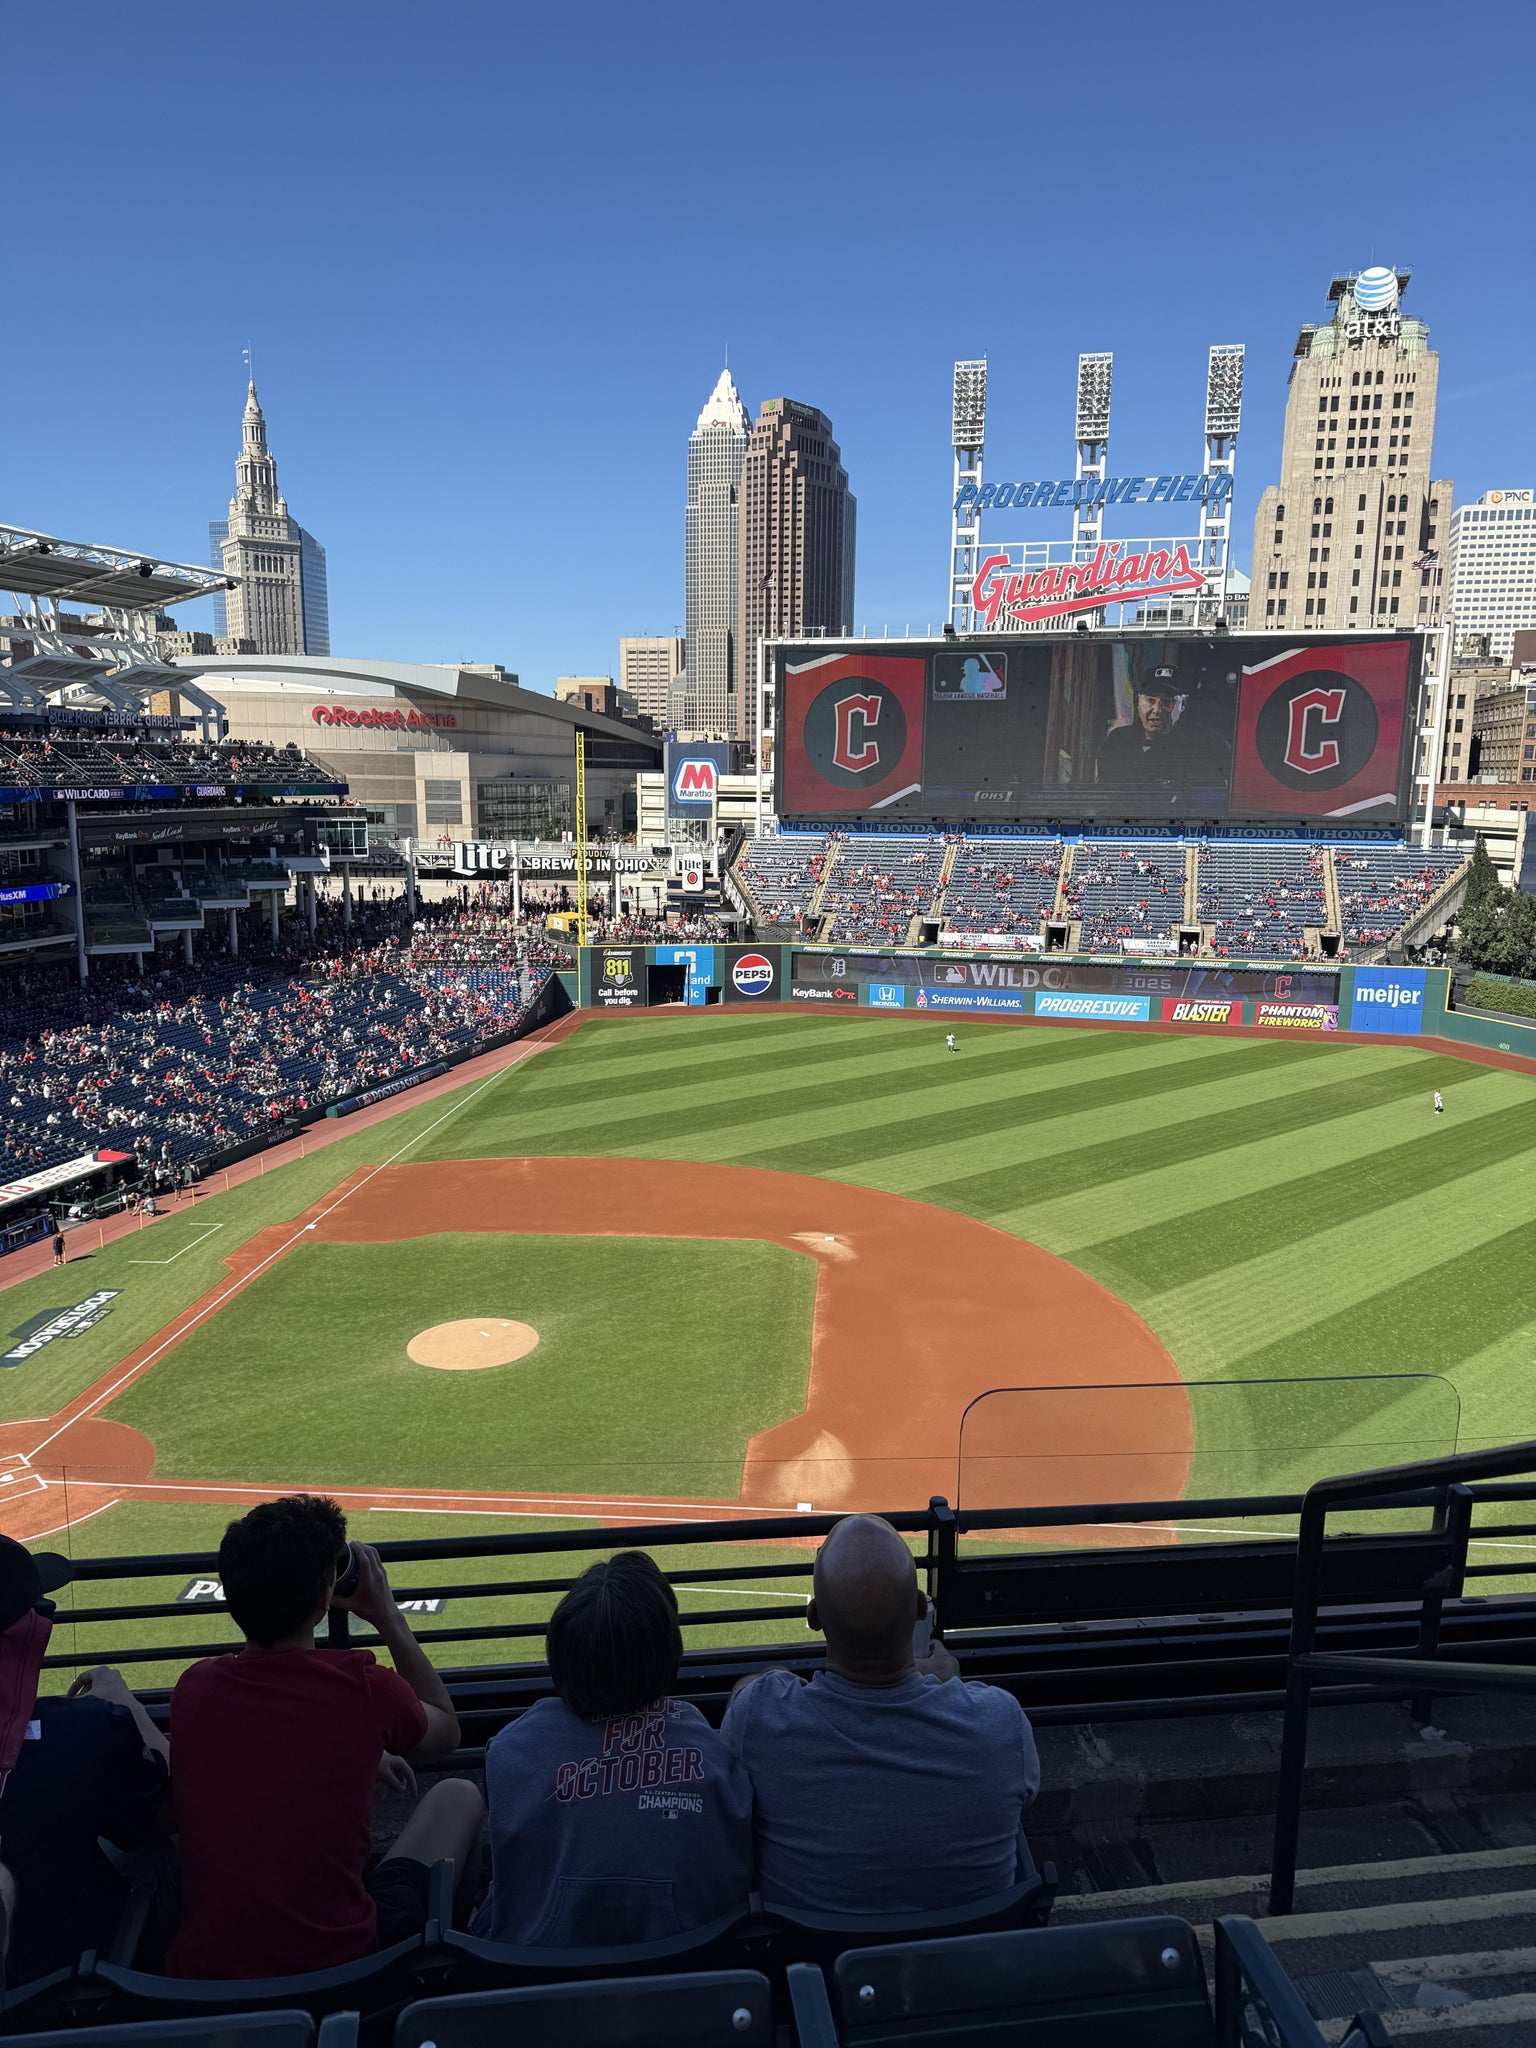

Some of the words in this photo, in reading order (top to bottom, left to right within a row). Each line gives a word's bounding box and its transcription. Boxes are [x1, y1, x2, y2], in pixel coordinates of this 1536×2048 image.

[1346, 312, 1401, 339] at&t
[953, 478, 1147, 510] PROGRESSIVE
[1147, 473, 1234, 503] FIELD
[1504, 491, 1530, 502] PNC
[971, 542, 1207, 626] Guardians
[49, 709, 74, 725] BLUE
[75, 712, 100, 724] MOON
[102, 712, 142, 725] TERRACE
[145, 716, 180, 728] GARDEN
[332, 705, 401, 725] Rocket
[405, 709, 457, 728] Arena
[832, 693, 882, 774] C
[1283, 688, 1347, 776] C
[196, 786, 227, 797] GUARDIANS
[680, 790, 713, 798] Maratho
[980, 792, 1004, 800] DHS
[798, 822, 858, 832] HONDA
[877, 823, 938, 833] HONDA
[986, 825, 1050, 835] HONDA
[1104, 826, 1172, 836] HONDA
[1228, 828, 1300, 838] HONDA
[115, 831, 138, 841] KeyBank
[1322, 829, 1395, 839] HONDA
[451, 842, 508, 876] Lite
[596, 859, 611, 871] IN
[614, 859, 649, 872] OHIO
[681, 860, 702, 871] Lite
[0, 890, 27, 901] iusXM
[606, 959, 629, 976] 811
[735, 969, 771, 979] PEPSI
[969, 964, 1040, 988] WILD
[1042, 967, 1073, 990] CA
[1474, 970, 1512, 983] PROGRESSIVE
[1123, 978, 1172, 990] 2025
[1275, 975, 1292, 999] C
[598, 988, 613, 997] Call
[614, 988, 639, 996] before
[792, 988, 833, 1000] KeyBank
[1356, 984, 1421, 1008] meijer
[604, 998, 618, 1006] you
[618, 996, 633, 1005] dig.
[1037, 997, 1141, 1016] PROGRESSIVE
[1172, 1003, 1232, 1023] BLASTER
[1260, 1005, 1324, 1018] PHANTOM
[1257, 1016, 1323, 1029] FIREWORKS
[1498, 1042, 1510, 1051] 400
[371, 1074, 420, 1102] POSTSEASON
[4, 1291, 119, 1358] POSTSEASON
[602, 1713, 666, 1757] FOR
[555, 1747, 705, 1802] OCTOBER
[638, 1794, 704, 1814] CHAMPIONS
